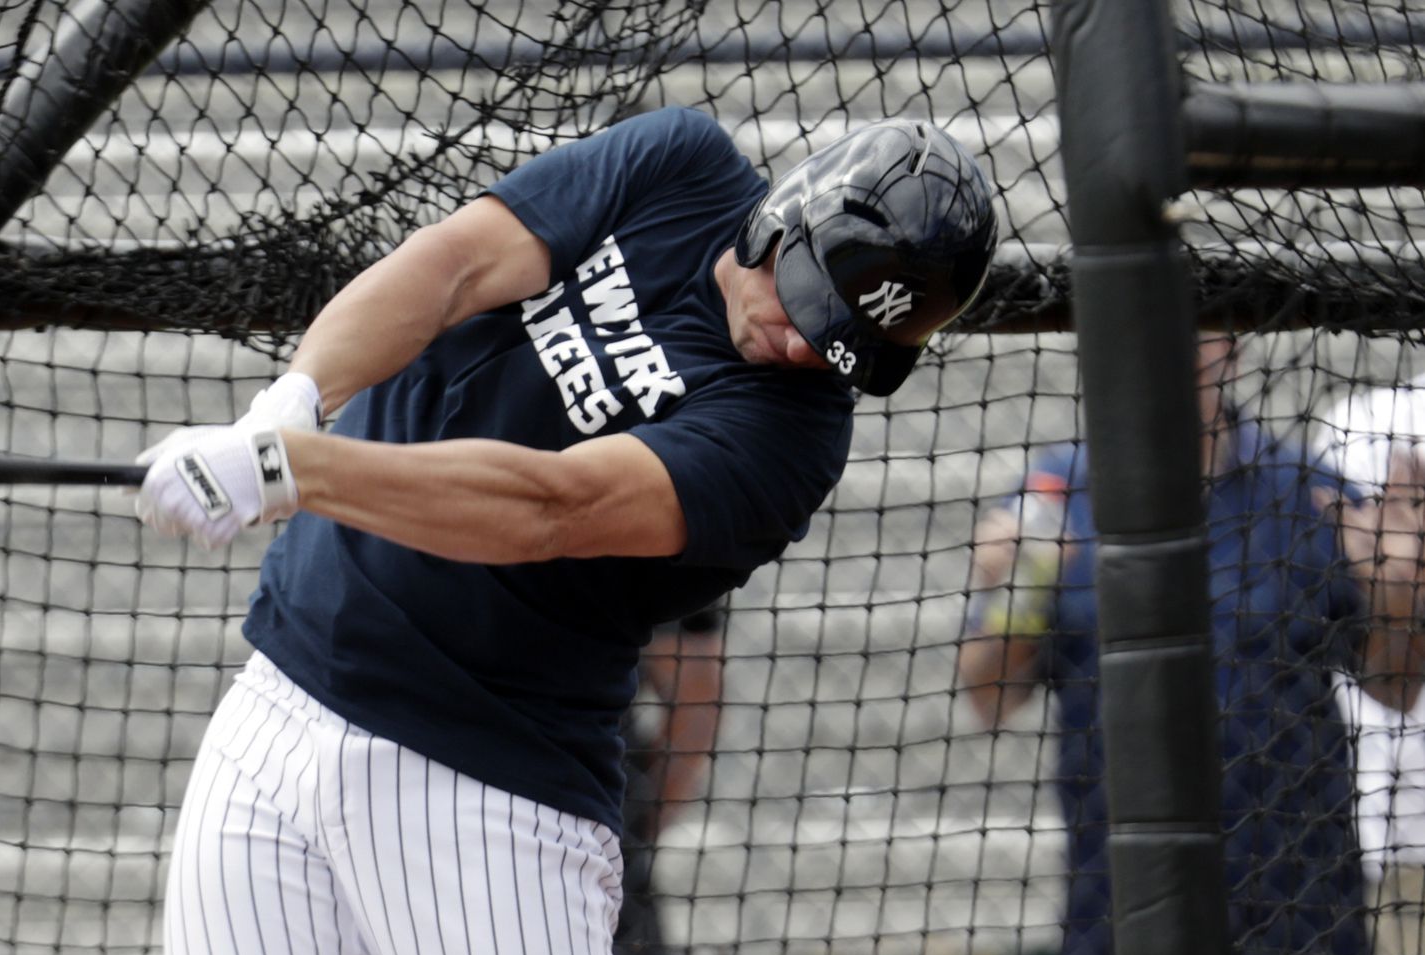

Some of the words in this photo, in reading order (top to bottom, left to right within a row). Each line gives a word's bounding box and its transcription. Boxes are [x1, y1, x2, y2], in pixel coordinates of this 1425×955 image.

[576, 234, 640, 325] EW
[858, 281, 913, 329] NY
[521, 281, 624, 435] NKEES
[826, 340, 857, 375] 33
